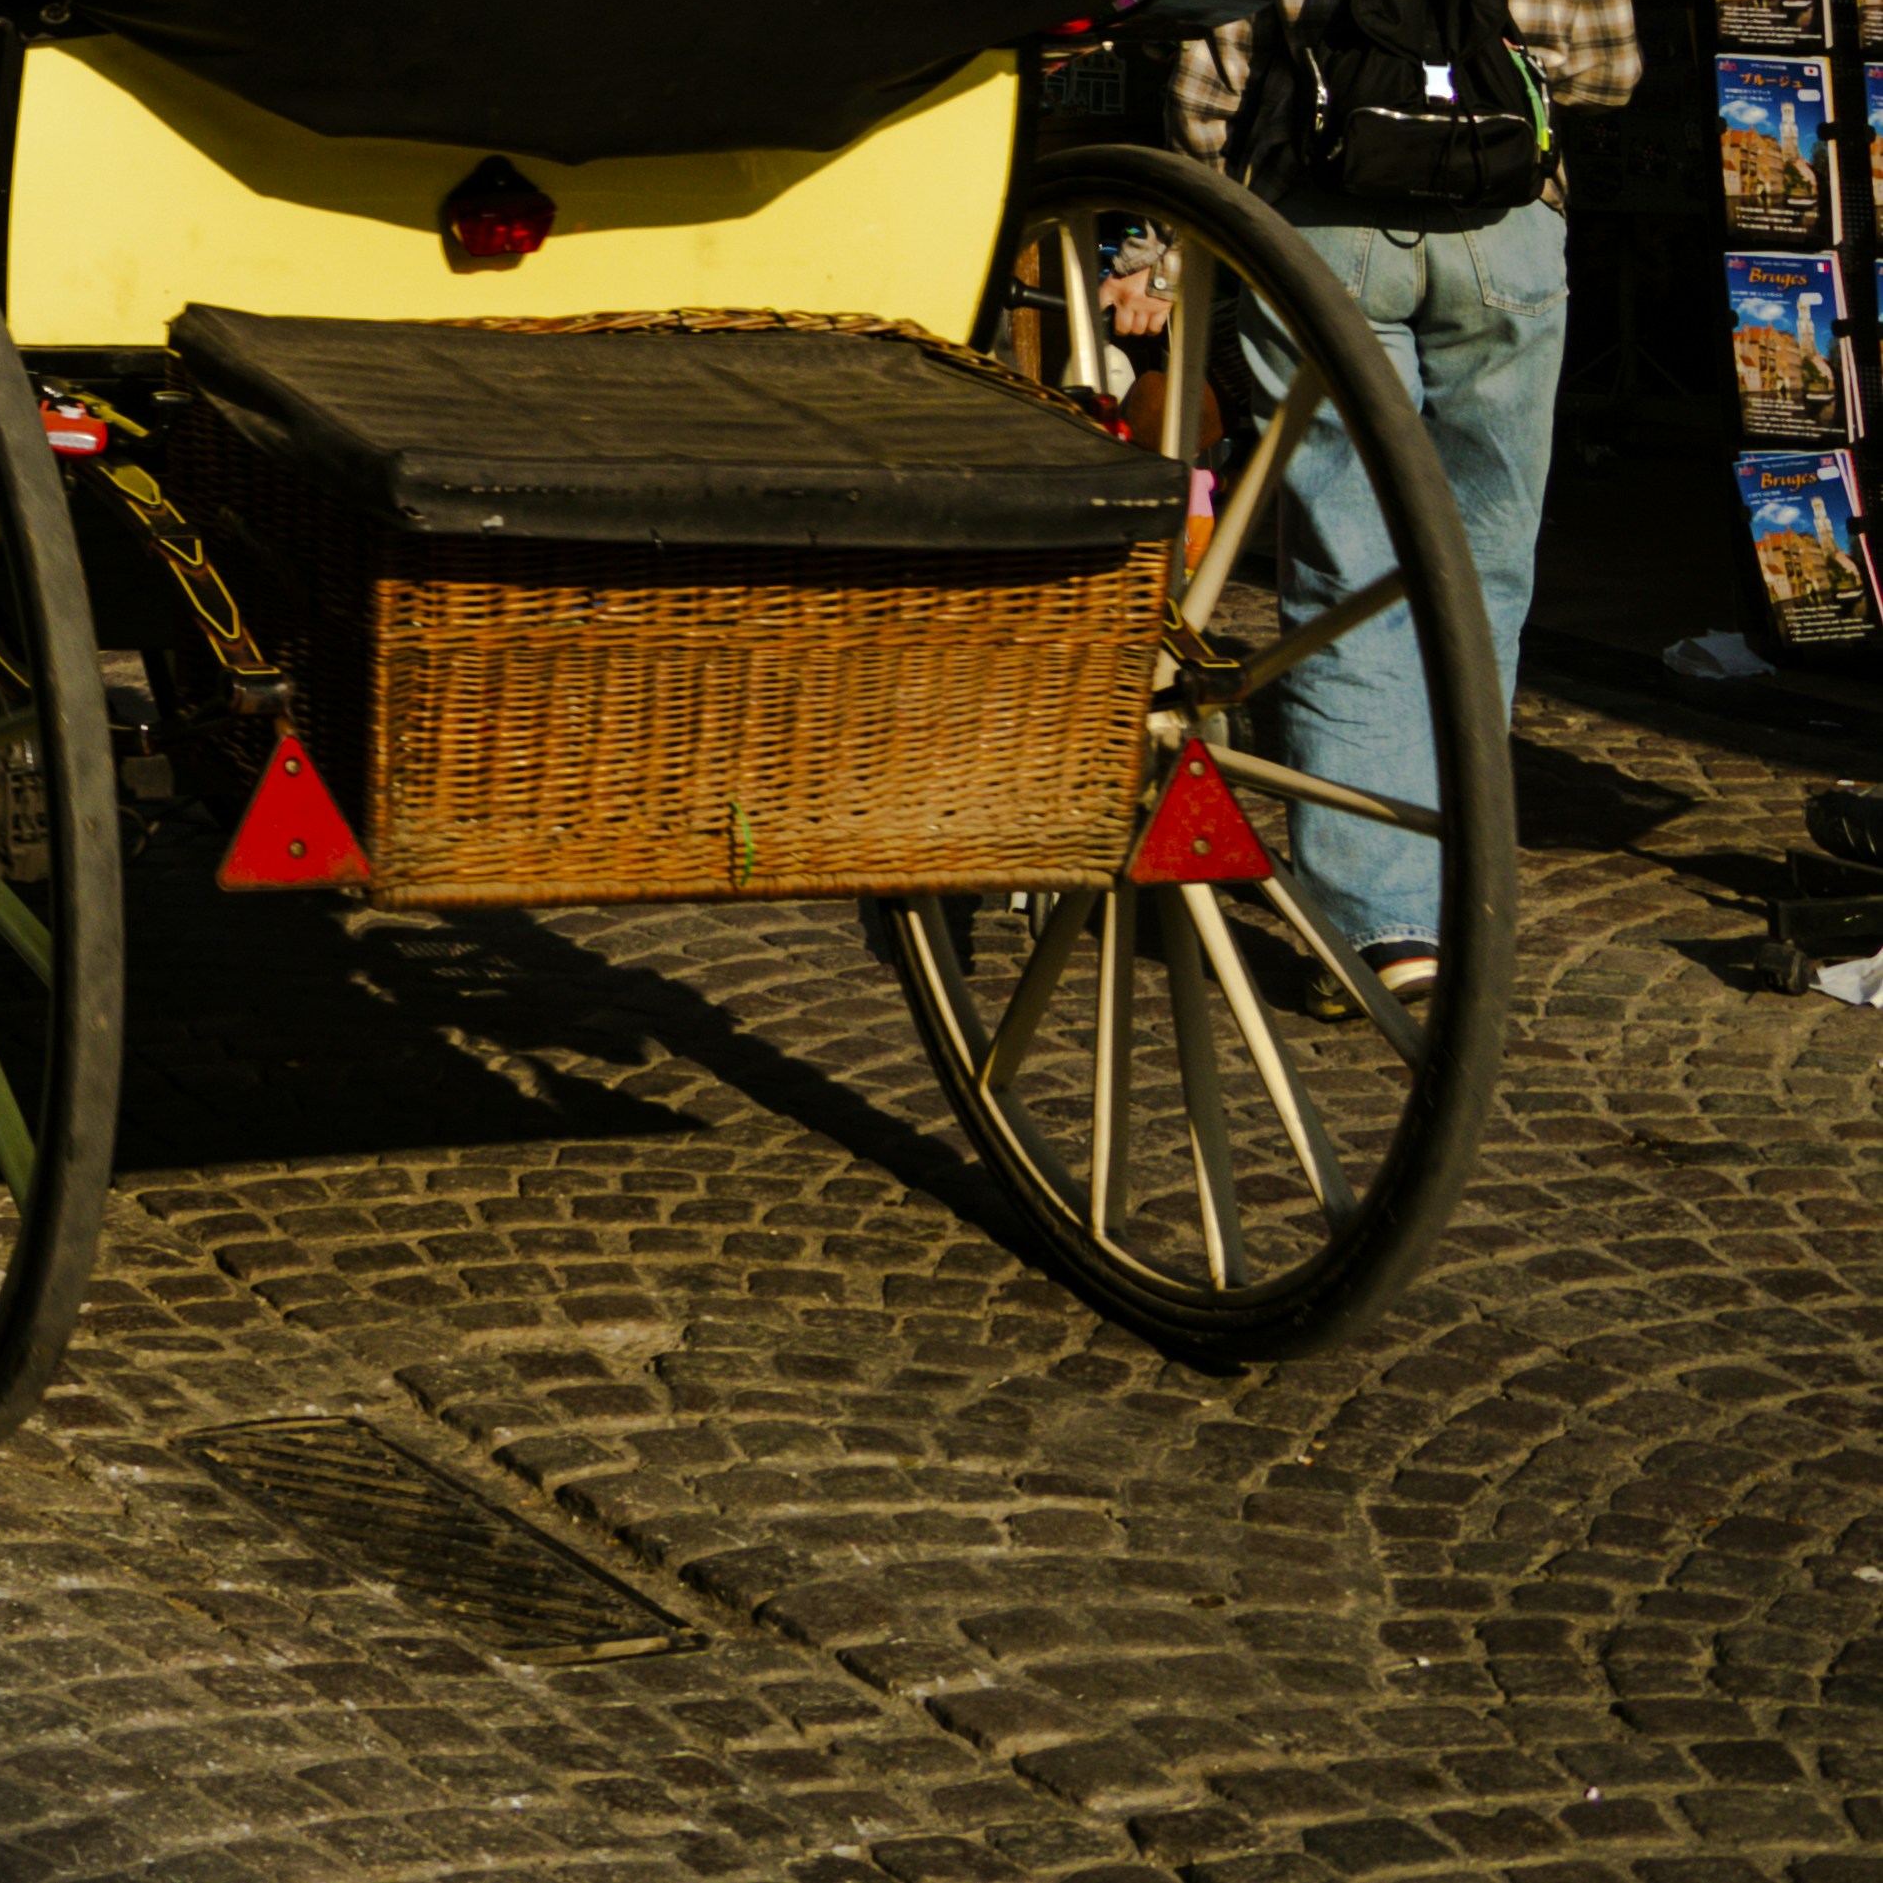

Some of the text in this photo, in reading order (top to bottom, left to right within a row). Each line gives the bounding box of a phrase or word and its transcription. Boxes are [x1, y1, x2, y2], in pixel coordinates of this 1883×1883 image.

[1739, 72, 1803, 89] ブルージュ
[1749, 267, 1808, 291] Bruges
[1760, 471, 1818, 493] Bruges
